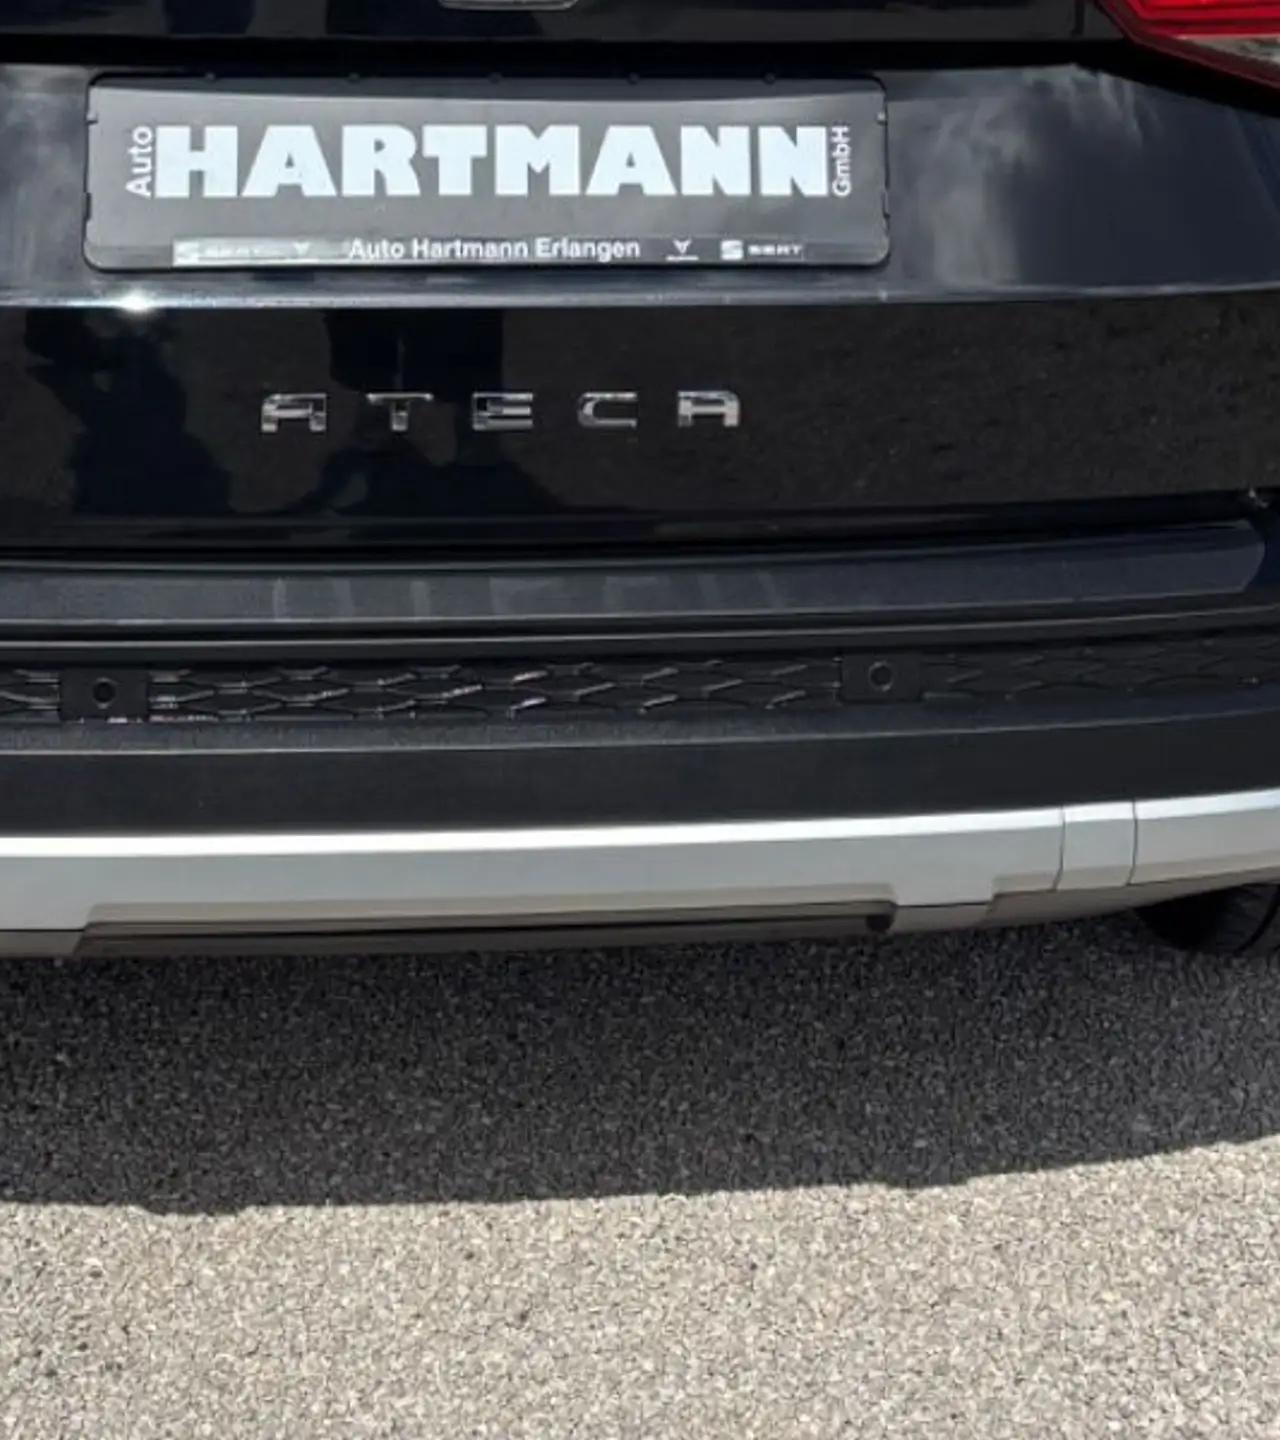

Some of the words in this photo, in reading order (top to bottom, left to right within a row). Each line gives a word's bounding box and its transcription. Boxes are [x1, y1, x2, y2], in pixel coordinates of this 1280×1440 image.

[125, 126, 153, 197] Auto
[154, 125, 828, 197] HARTMANN
[831, 126, 852, 197] GmbH
[349, 237, 404, 258] Auto
[412, 237, 529, 259] Hartmann
[535, 237, 639, 261] Erlangen
[261, 391, 740, 432] ATECA
